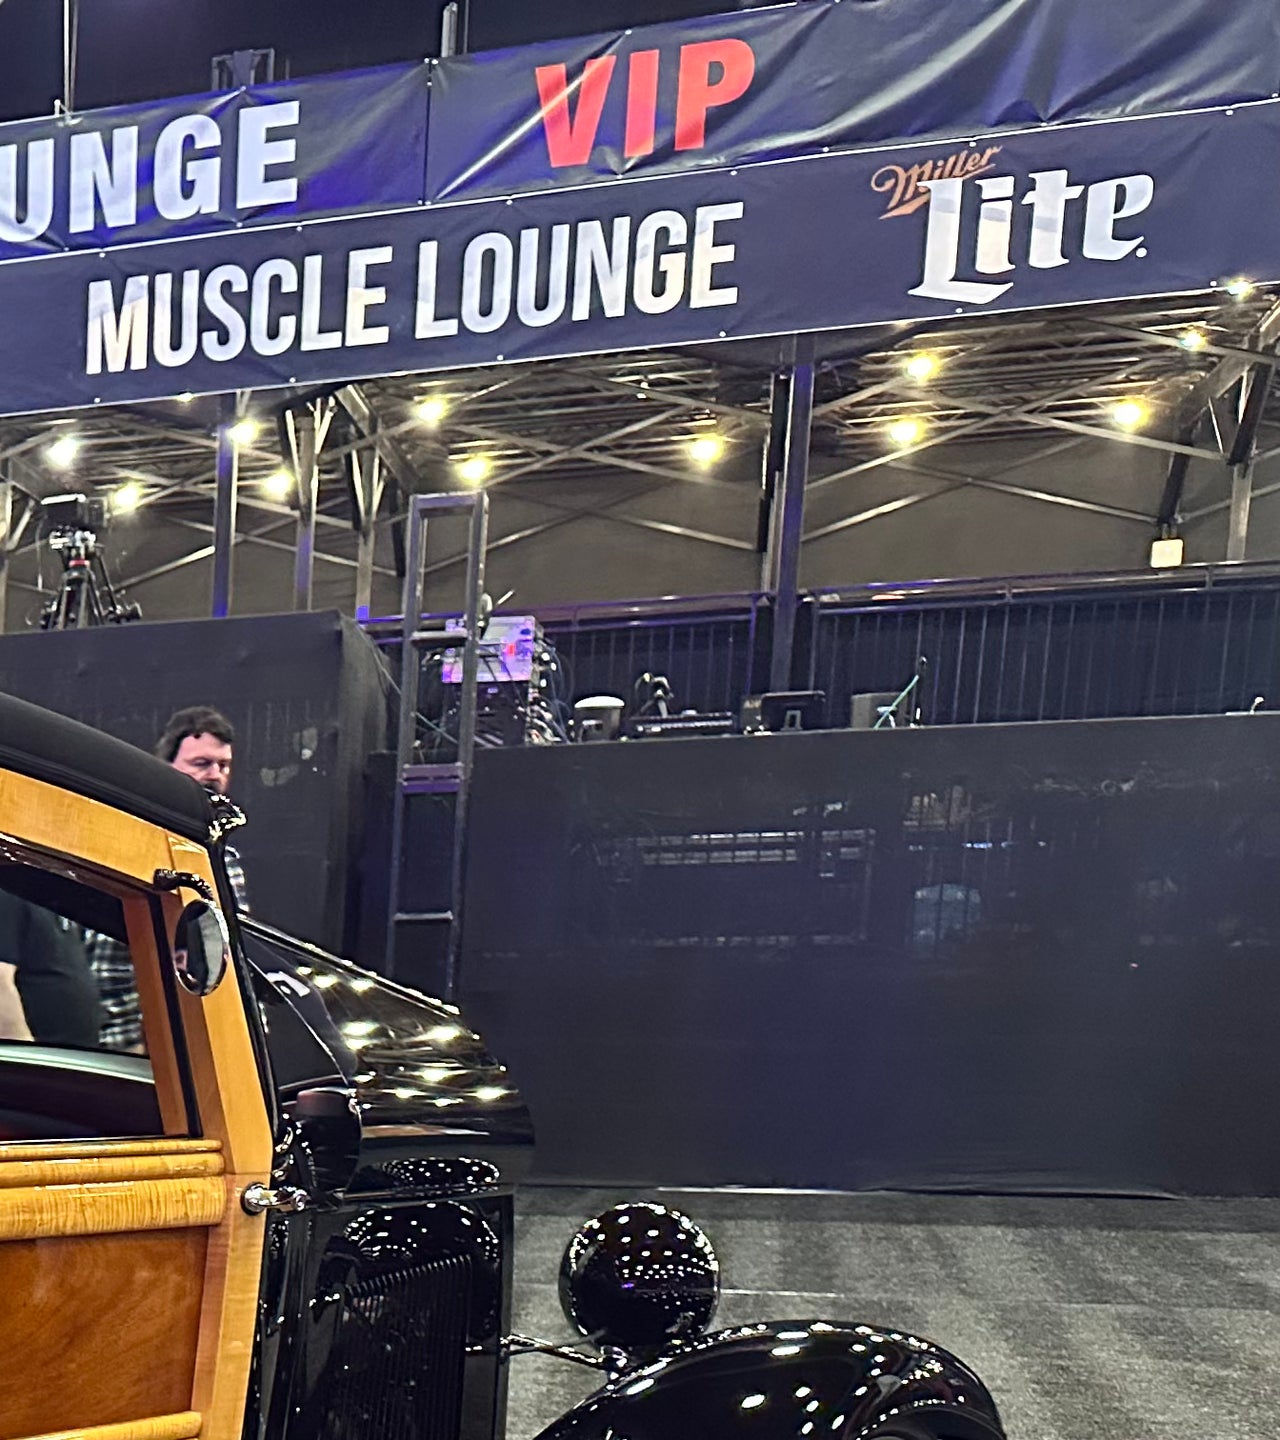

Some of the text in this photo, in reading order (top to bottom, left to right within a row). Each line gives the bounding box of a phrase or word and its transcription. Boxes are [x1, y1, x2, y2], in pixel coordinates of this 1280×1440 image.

[536, 38, 755, 168] VIP
[871, 146, 1002, 219] Miller
[908, 169, 1153, 304] Lite
[86, 202, 744, 376] MUSCLE LOUNGE
